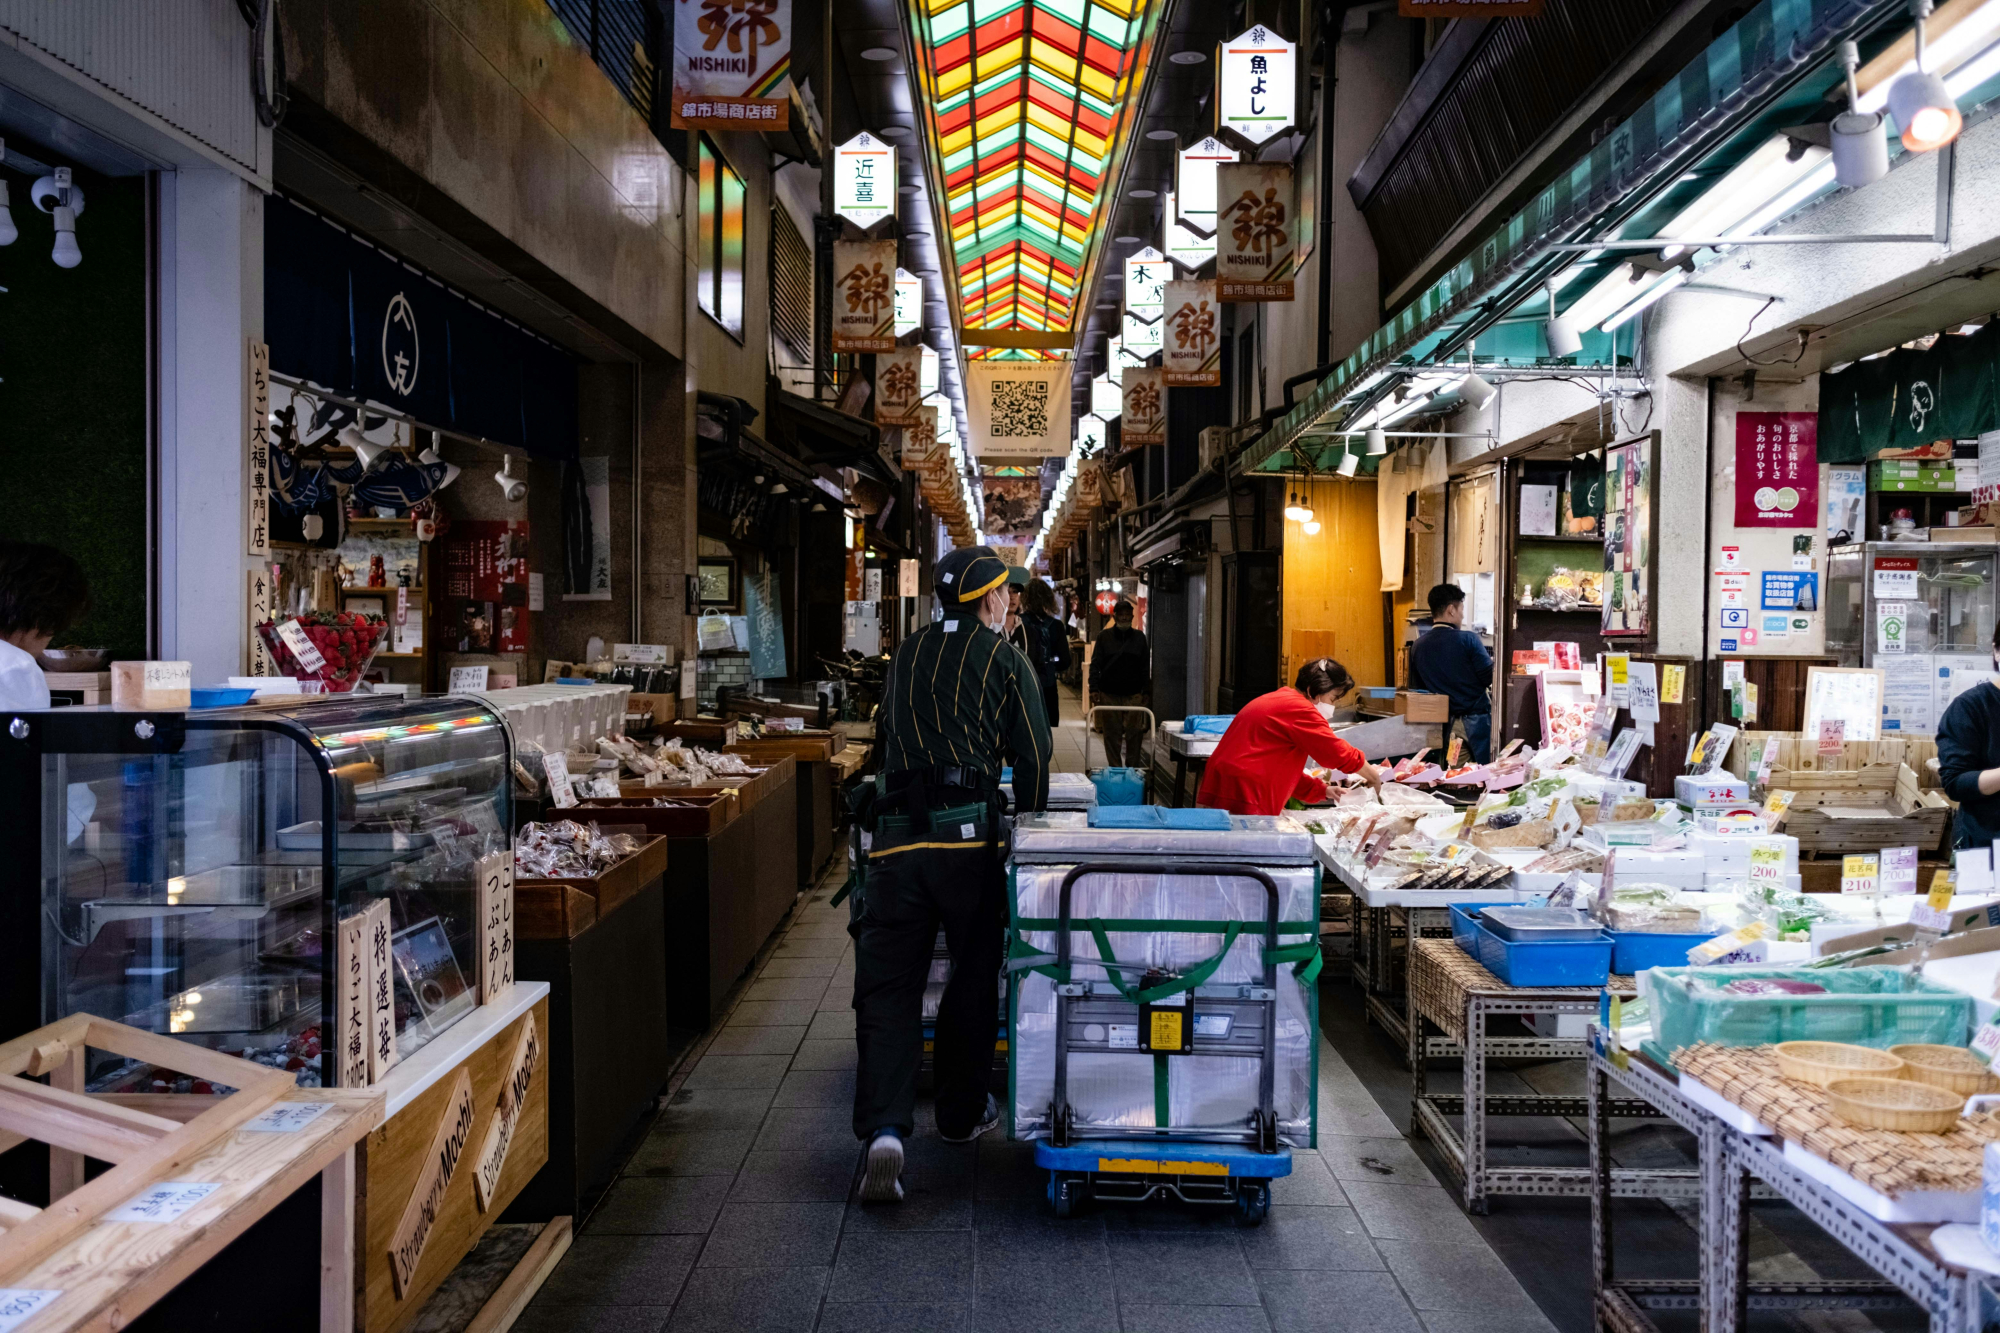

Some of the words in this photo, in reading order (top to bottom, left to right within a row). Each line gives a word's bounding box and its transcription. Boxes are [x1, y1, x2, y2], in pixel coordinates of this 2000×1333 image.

[688, 56, 746, 73] NISHIKI
[1250, 55, 1268, 115] 魚よし
[681, 102, 778, 120] 錦市場商店街
[855, 158, 874, 202] 近喜
[1220, 187, 1287, 269] 錦
[1226, 254, 1266, 266] NISHIKI
[837, 262, 890, 327] 錦
[1222, 283, 1287, 296] 錦市場商店街
[841, 315, 873, 325] NISHIKI
[1166, 300, 1217, 361] 錦
[837, 339, 890, 350] 錦市場商店街
[1170, 351, 1201, 360] NISHIKI
[879, 361, 918, 409] 錦
[881, 400, 905, 409] NISHIKI
[1124, 381, 1160, 426] 錦
[252, 344, 267, 548] いちご大福専門店
[1756, 424, 1766, 480] おあがりやす
[1772, 424, 1782, 480] 旬のおいしさ
[1788, 424, 1798, 480] 京都で採れた
[1765, 589, 1794, 597] 取扱店舗
[1753, 850, 1781, 861] みつ葉
[1884, 857, 1909, 865] ししとう
[487, 875, 499, 995] つぶあん
[501, 867, 514, 986] こしあん
[347, 929, 362, 1057] いちご大福
[483, 1099, 516, 1198] Strawberry
[512, 1028, 539, 1113] Mochi
[399, 1182, 443, 1286] Strawberry
[440, 1090, 471, 1188] Mochi
